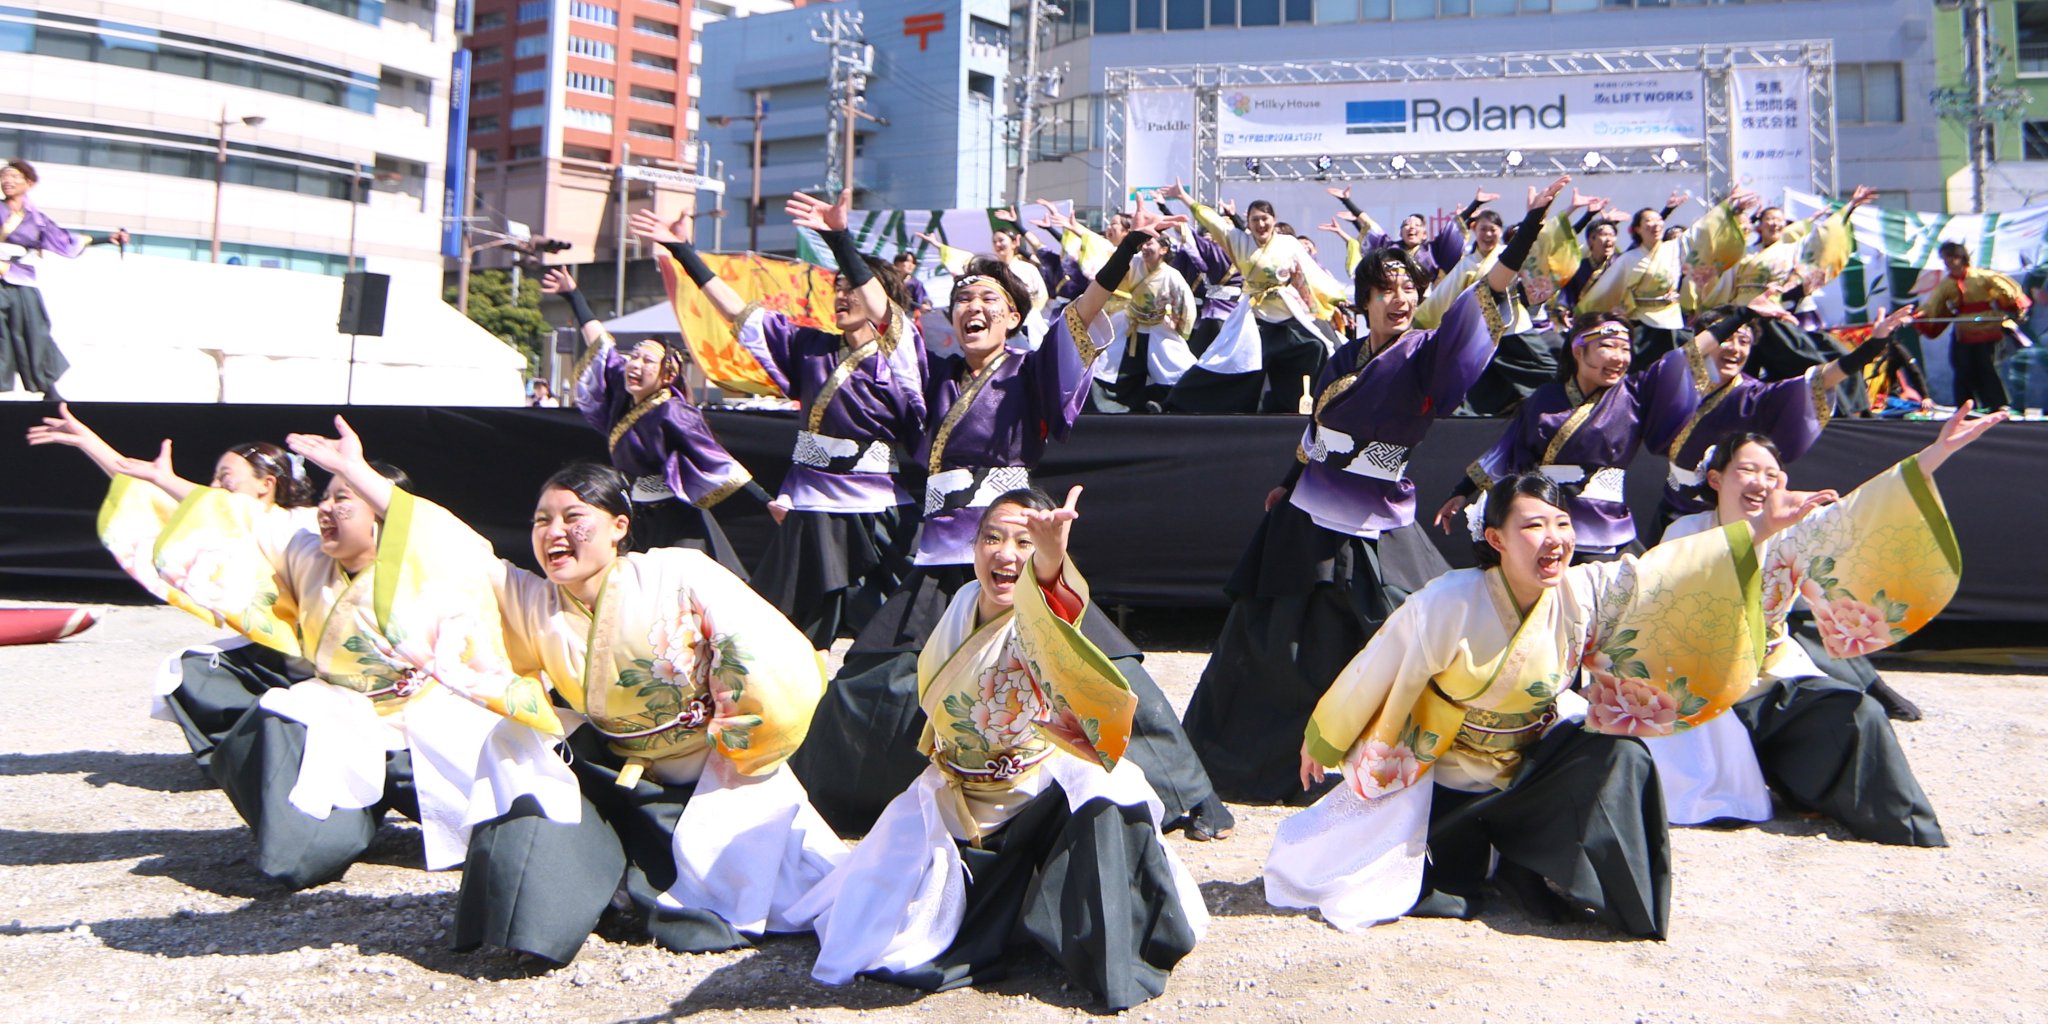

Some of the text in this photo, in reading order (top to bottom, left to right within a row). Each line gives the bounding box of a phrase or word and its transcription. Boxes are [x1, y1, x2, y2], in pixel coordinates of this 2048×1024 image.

[1612, 92, 1640, 103] LIFT
[1643, 90, 1694, 102] WORKS
[1255, 99, 1320, 110] Milky House
[1744, 98, 1798, 112] 土地開発
[1412, 94, 1566, 132] Roland
[1147, 120, 1191, 132] Paddle
[1741, 116, 1798, 129] 株式会社
